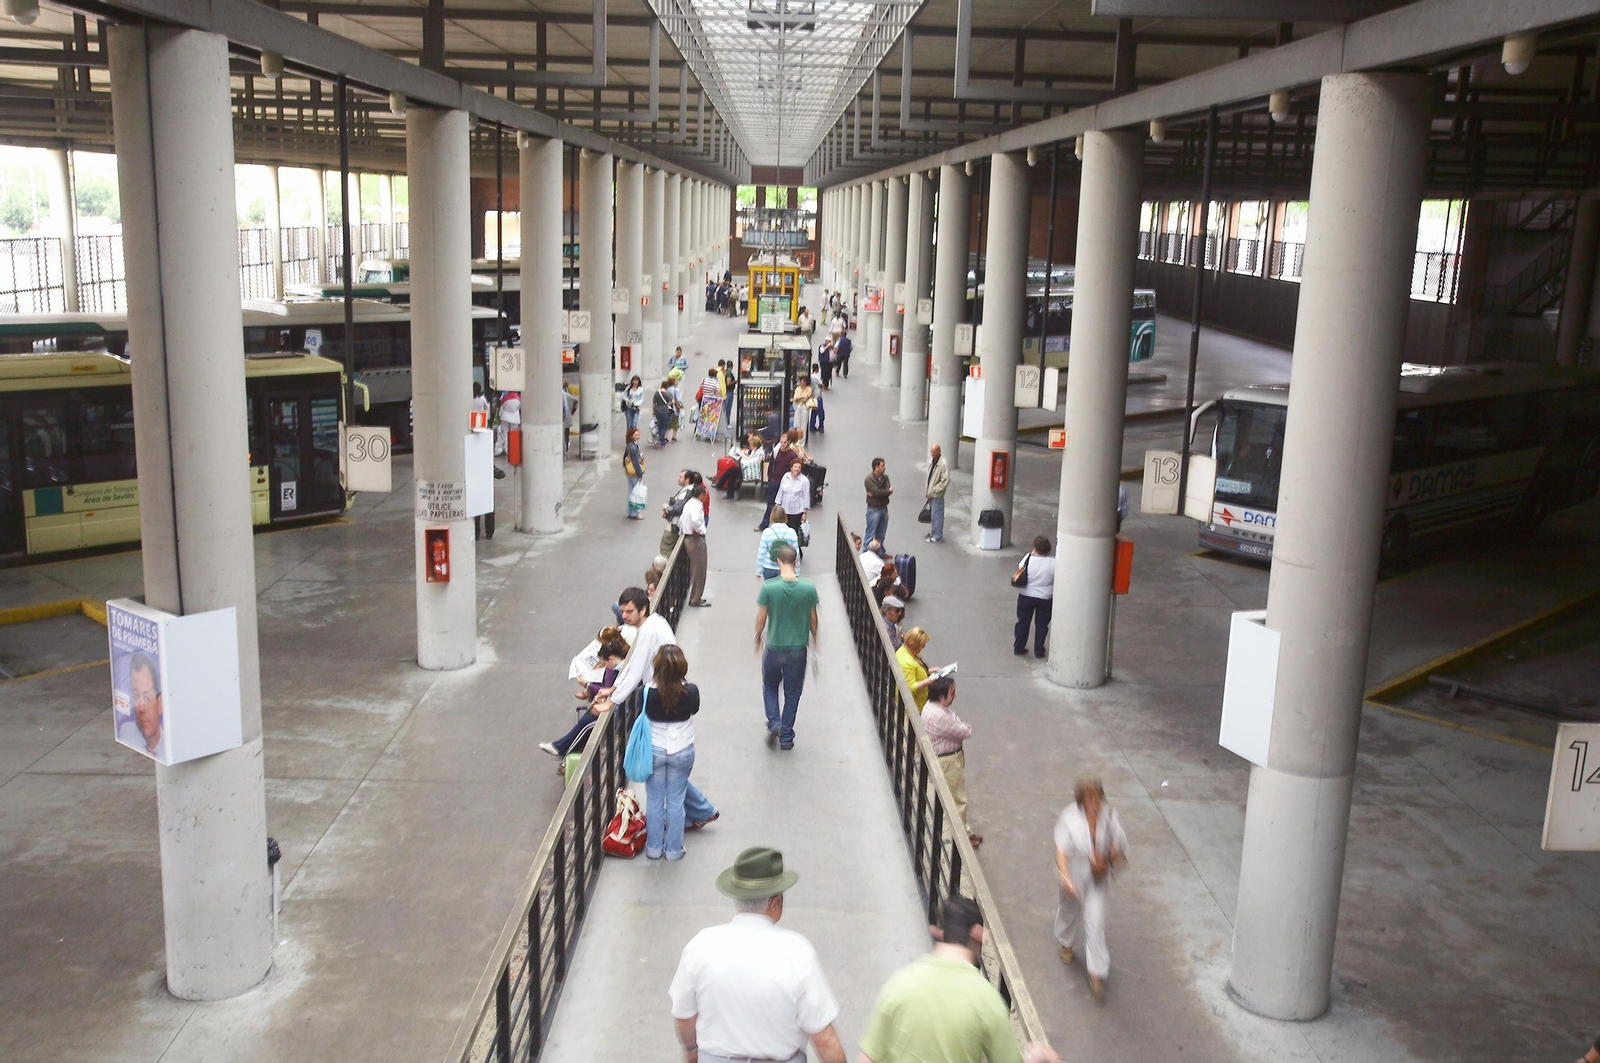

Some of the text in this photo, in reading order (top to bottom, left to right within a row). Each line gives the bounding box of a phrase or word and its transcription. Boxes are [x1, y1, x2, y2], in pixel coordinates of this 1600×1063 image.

[613, 290, 628, 303] 33
[897, 285, 904, 295] 9
[919, 301, 932, 313] 10
[570, 314, 589, 329] 32
[959, 326, 970, 341] 11
[501, 352, 521, 372] 31
[1019, 369, 1038, 389] 12
[348, 433, 389, 462] 30
[1152, 456, 1180, 485] 13
[112, 492, 134, 501] Sevilla
[430, 509, 464, 518] PAPELERAS
[1243, 510, 1276, 528] DAM
[110, 609, 158, 640] TOMARES
[111, 625, 122, 641] DE
[122, 630, 159, 655] PRIMERA
